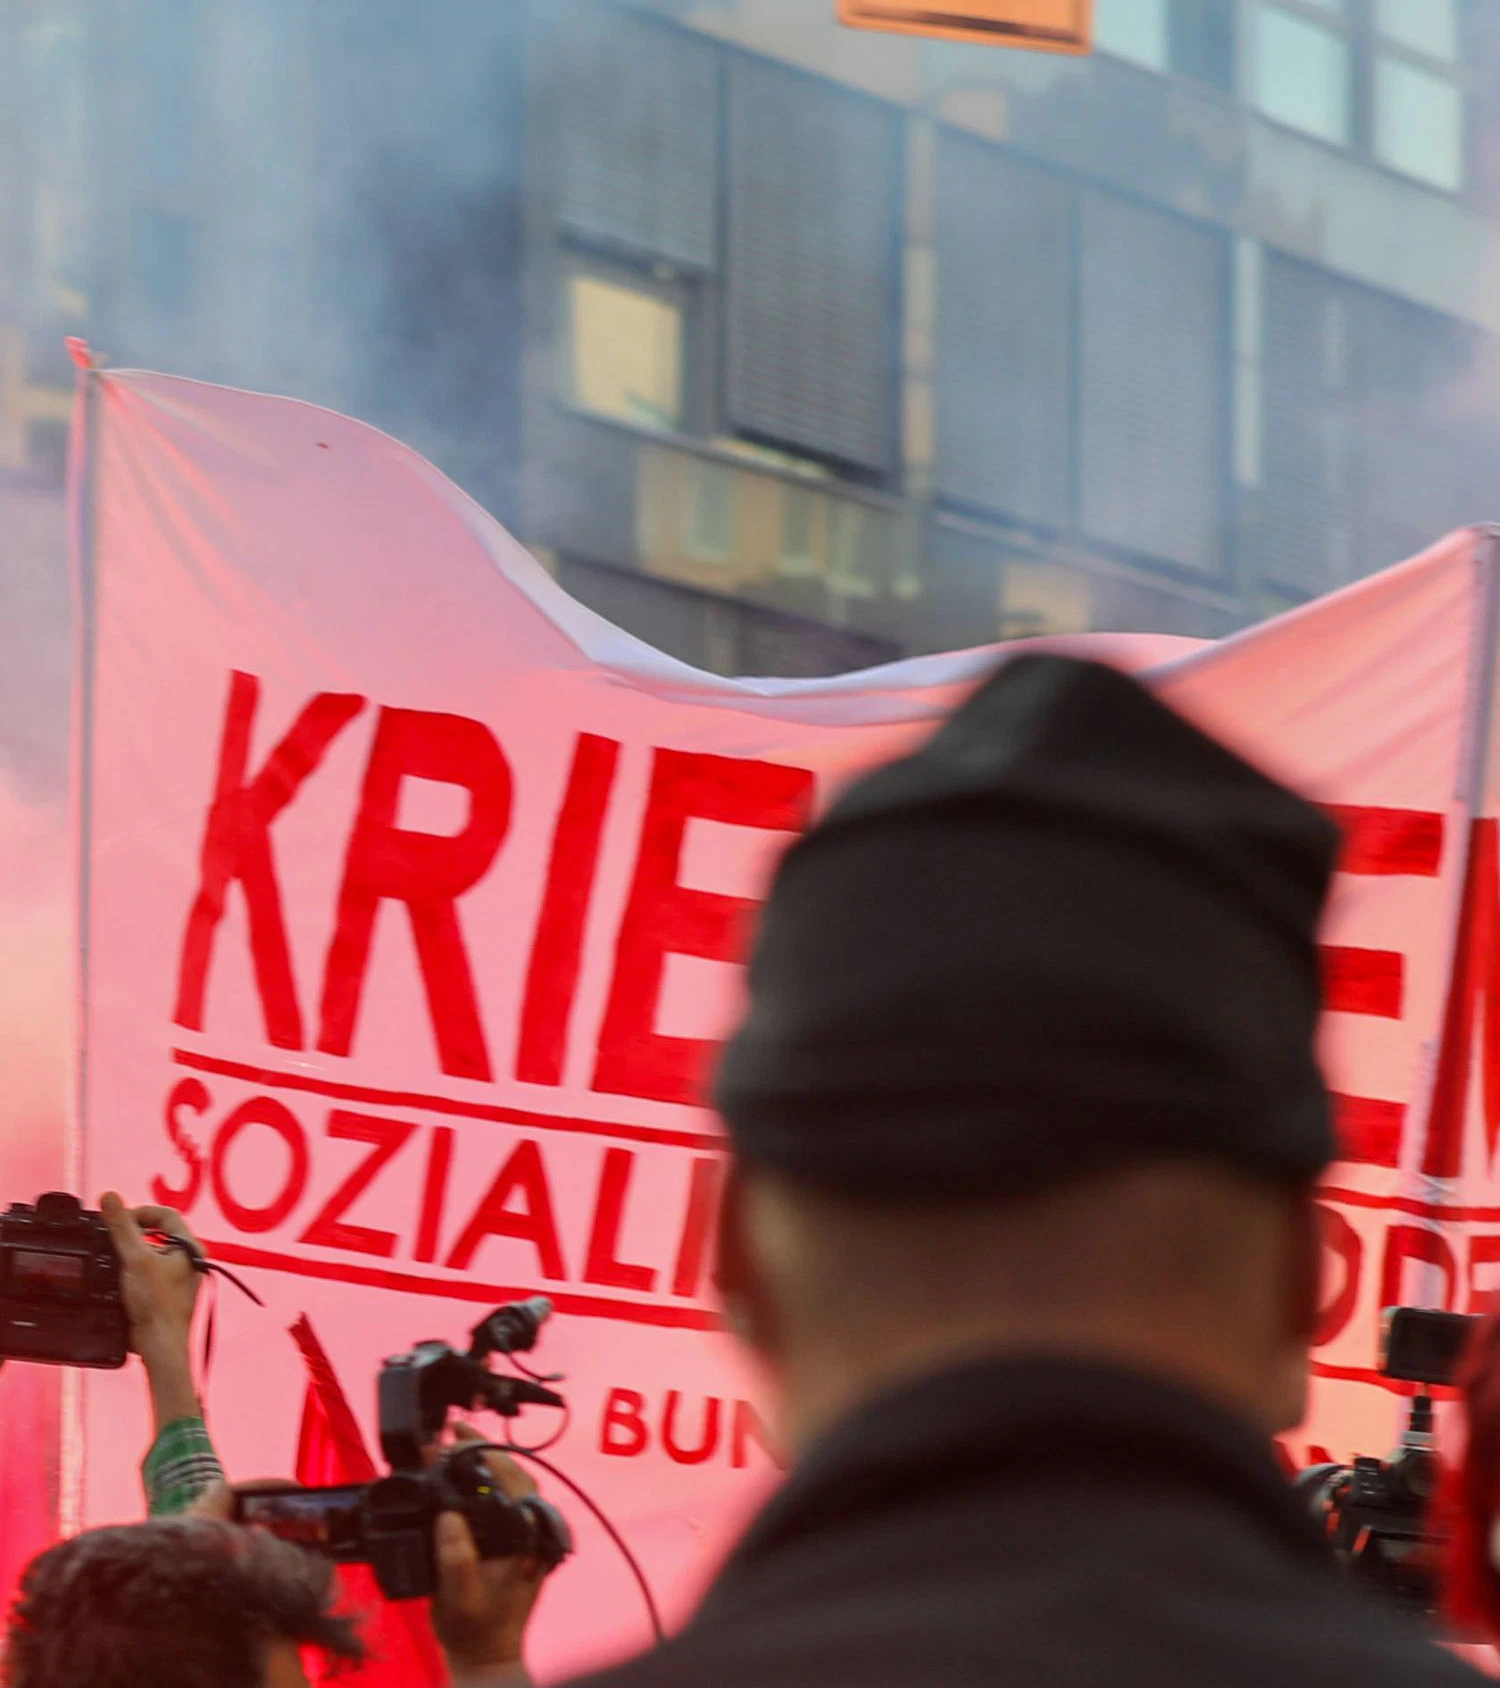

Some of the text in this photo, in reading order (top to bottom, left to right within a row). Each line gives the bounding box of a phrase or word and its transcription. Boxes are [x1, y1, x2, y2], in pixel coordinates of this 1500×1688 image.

[174, 670, 818, 1109] KRIE
[151, 1078, 730, 1298] SOZIALI
[598, 1386, 792, 1472] BUN
